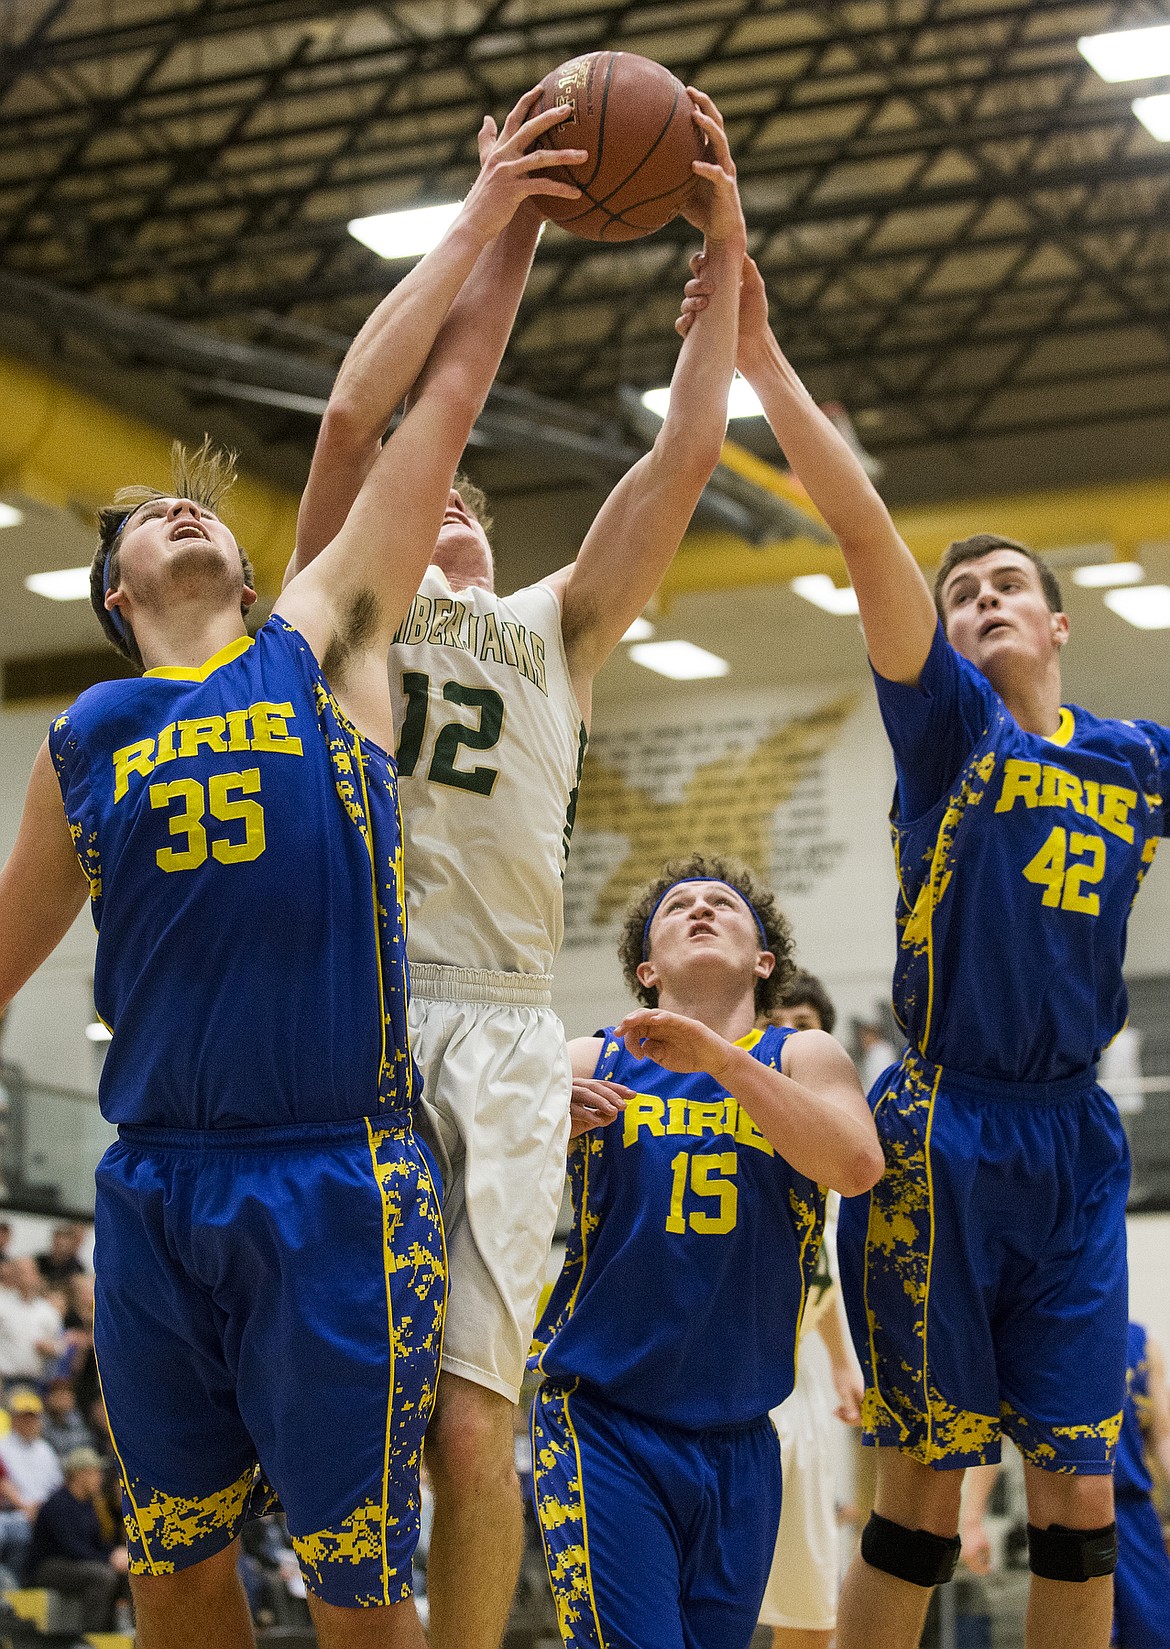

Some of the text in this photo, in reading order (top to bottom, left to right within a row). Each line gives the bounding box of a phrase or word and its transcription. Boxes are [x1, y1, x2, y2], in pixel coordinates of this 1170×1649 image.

[112, 701, 304, 804] RIRIE
[396, 670, 504, 798] 12
[149, 767, 266, 873] 35
[994, 758, 1138, 845] RIRIE
[1021, 825, 1107, 917] 42
[665, 1151, 738, 1235] 15
